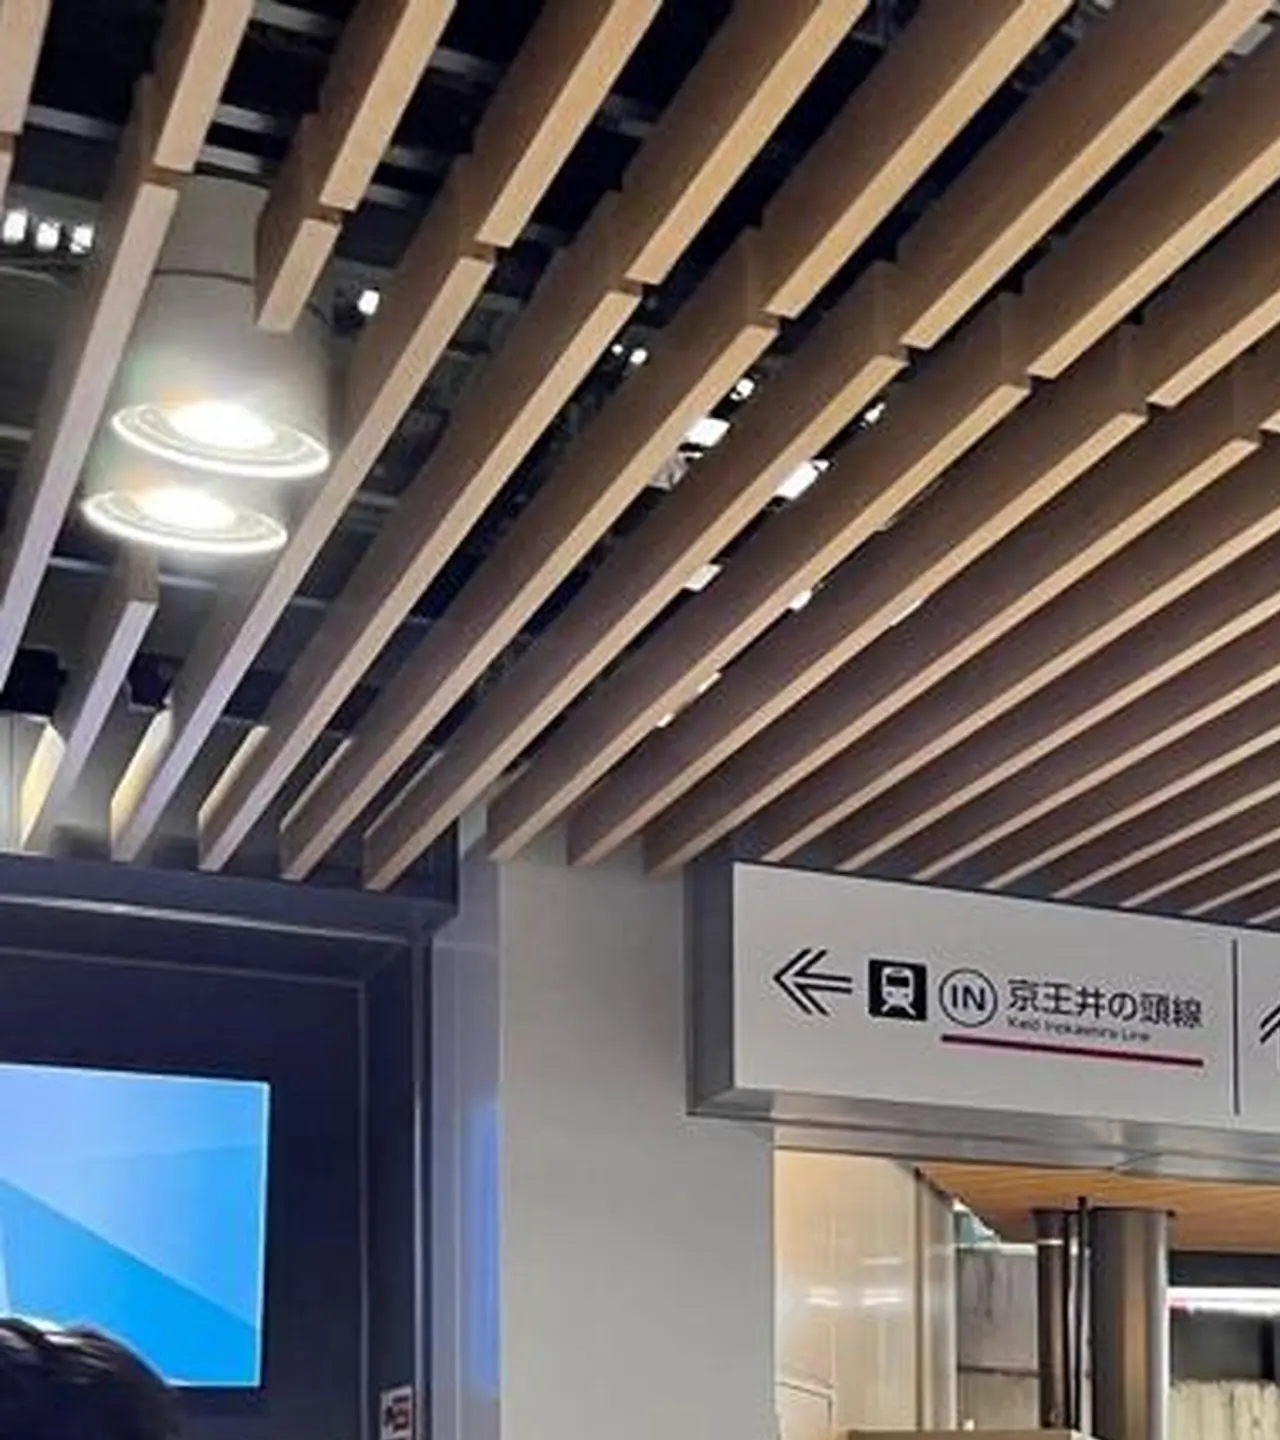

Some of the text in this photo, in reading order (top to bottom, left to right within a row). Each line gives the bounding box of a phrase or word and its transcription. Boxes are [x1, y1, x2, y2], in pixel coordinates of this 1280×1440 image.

[951, 983, 985, 1011] IN
[1007, 978, 1203, 1030] 京王井の頭線
